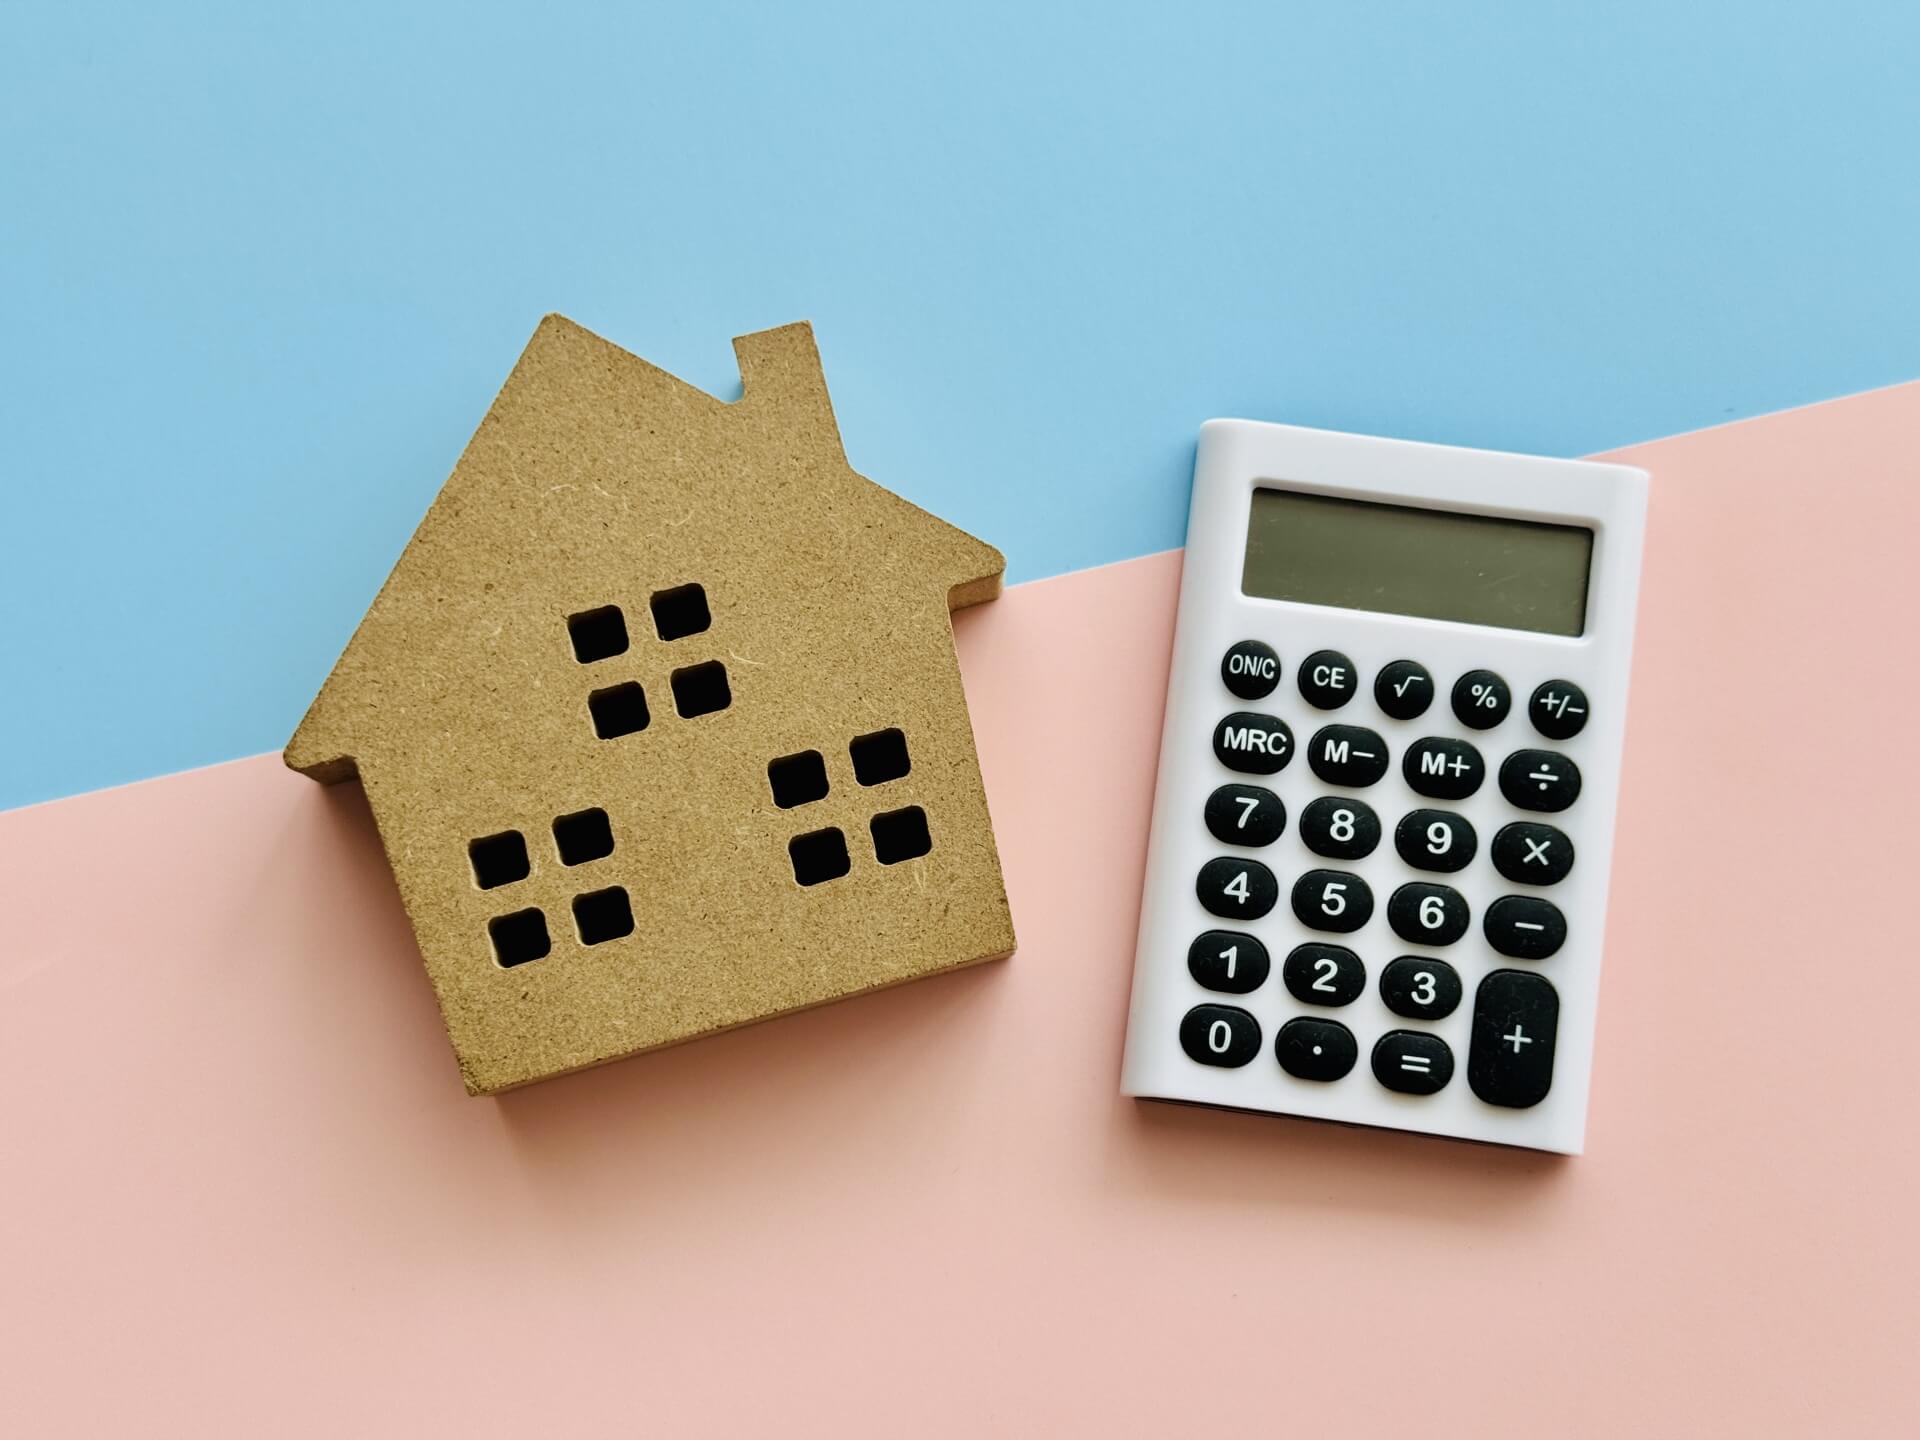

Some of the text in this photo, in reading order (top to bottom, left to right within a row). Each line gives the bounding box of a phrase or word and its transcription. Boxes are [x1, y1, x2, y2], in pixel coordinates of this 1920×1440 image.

[1229, 654, 1276, 679] ON/C
[1313, 665, 1346, 689] CE
[1471, 684, 1497, 709] %
[1223, 726, 1288, 755] MRC
[1421, 751, 1471, 778] M+
[1235, 796, 1260, 829] 7
[1329, 808, 1355, 842] 8
[1426, 821, 1453, 855] 9
[1223, 871, 1251, 904] 4
[1321, 882, 1347, 916] 5
[1419, 896, 1445, 929] 6
[1219, 945, 1238, 979] 1
[1311, 958, 1338, 992] 2
[1411, 971, 1436, 1005] 3
[1208, 1020, 1232, 1053] 0
